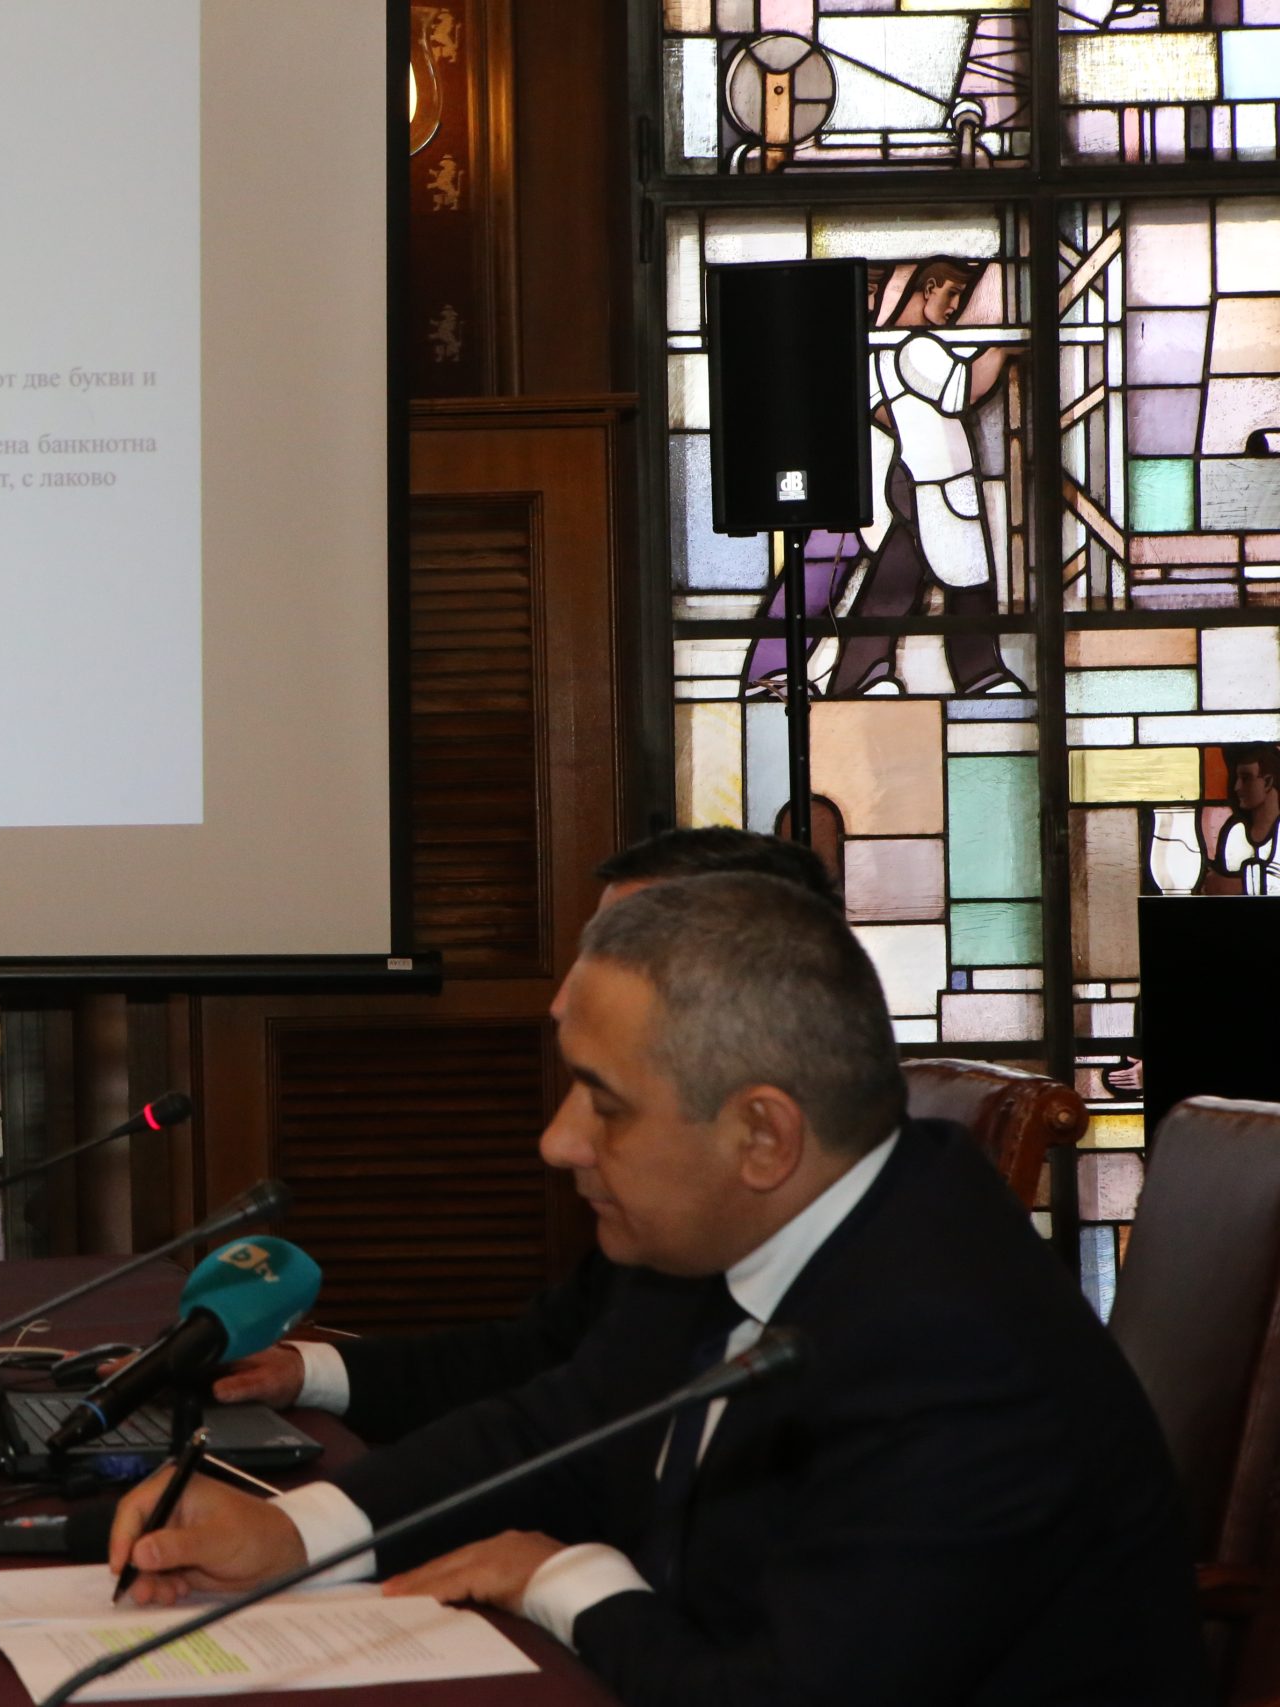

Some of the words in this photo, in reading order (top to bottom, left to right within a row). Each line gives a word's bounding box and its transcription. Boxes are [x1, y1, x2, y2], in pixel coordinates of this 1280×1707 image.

[22, 372, 61, 390] две
[70, 366, 134, 393] букви
[143, 370, 157, 387] и
[38, 433, 158, 454] банкнотна
[21, 471, 34, 487] с
[39, 469, 116, 487] лаково
